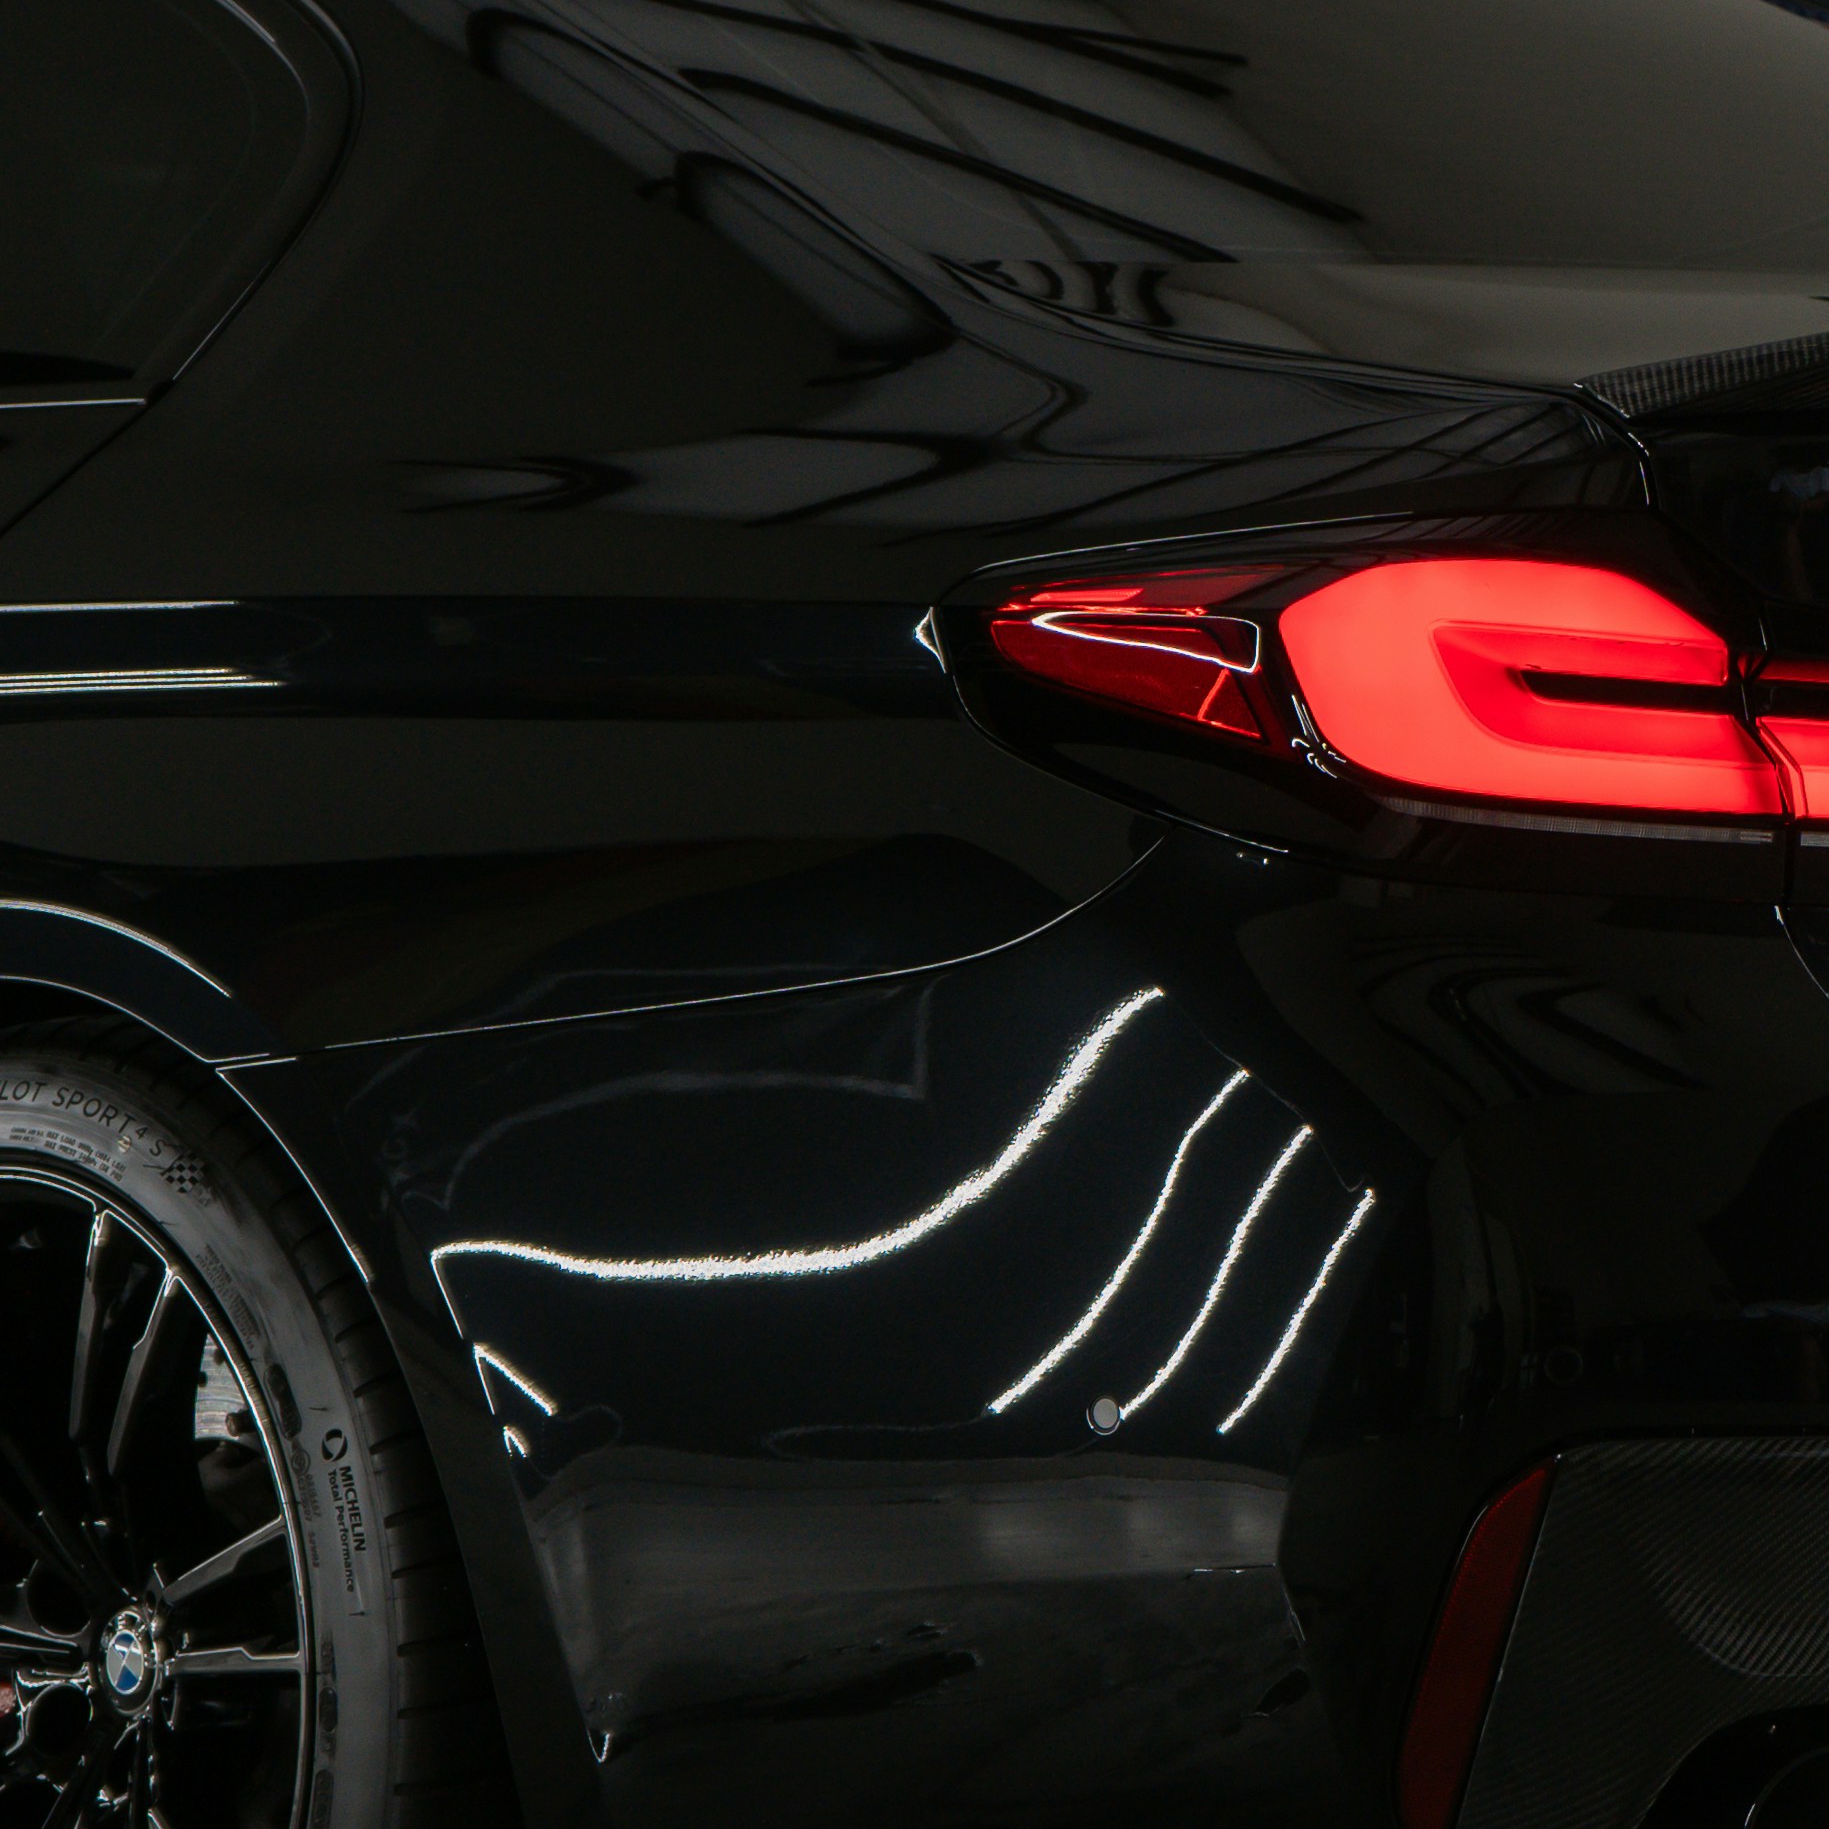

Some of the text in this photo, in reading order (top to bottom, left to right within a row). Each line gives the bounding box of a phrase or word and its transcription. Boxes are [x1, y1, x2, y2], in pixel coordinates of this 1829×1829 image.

[52, 1086, 135, 1134] SPORT
[135, 1126, 149, 1140] 4
[149, 1138, 167, 1157] S
[327, 1469, 355, 1593] Total Performance
[339, 1466, 367, 1552] MICHELIN
